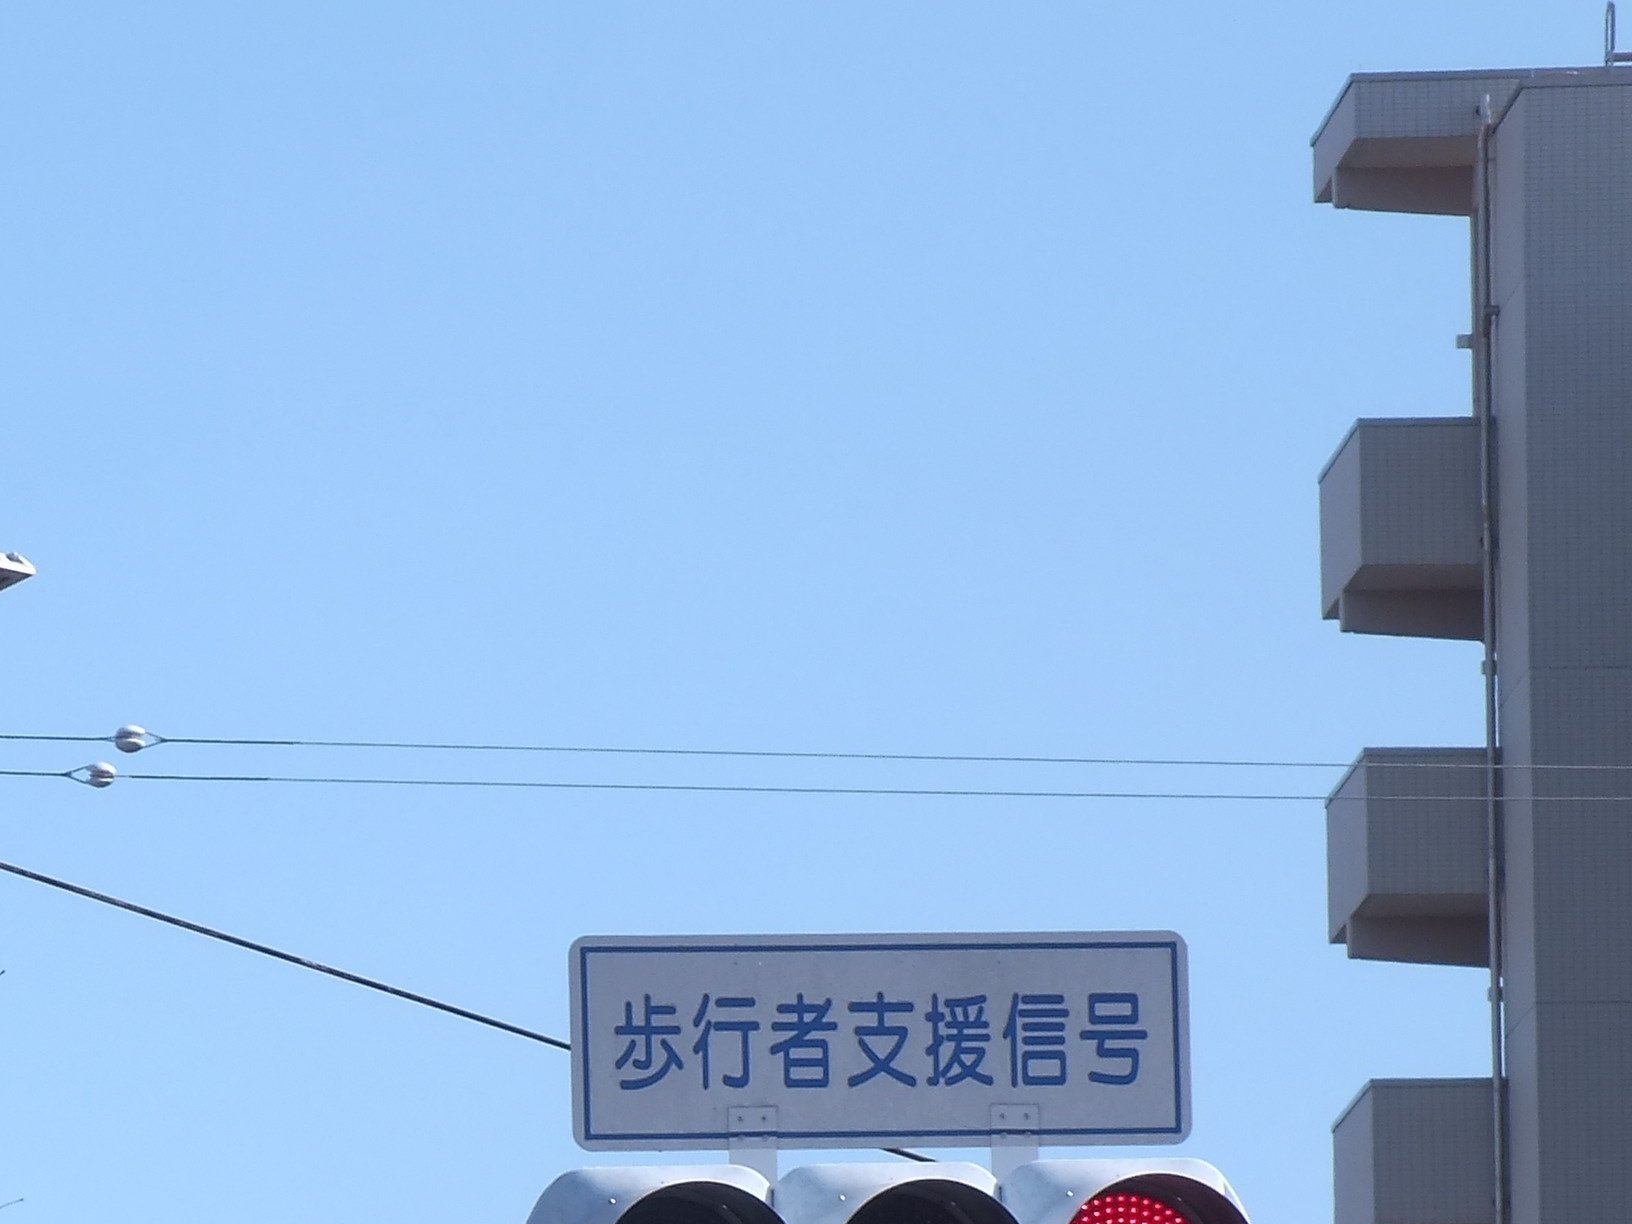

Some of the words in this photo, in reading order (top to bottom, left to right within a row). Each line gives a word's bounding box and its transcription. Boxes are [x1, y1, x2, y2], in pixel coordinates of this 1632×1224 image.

[614, 991, 1149, 1091] 歩行者支援信号
